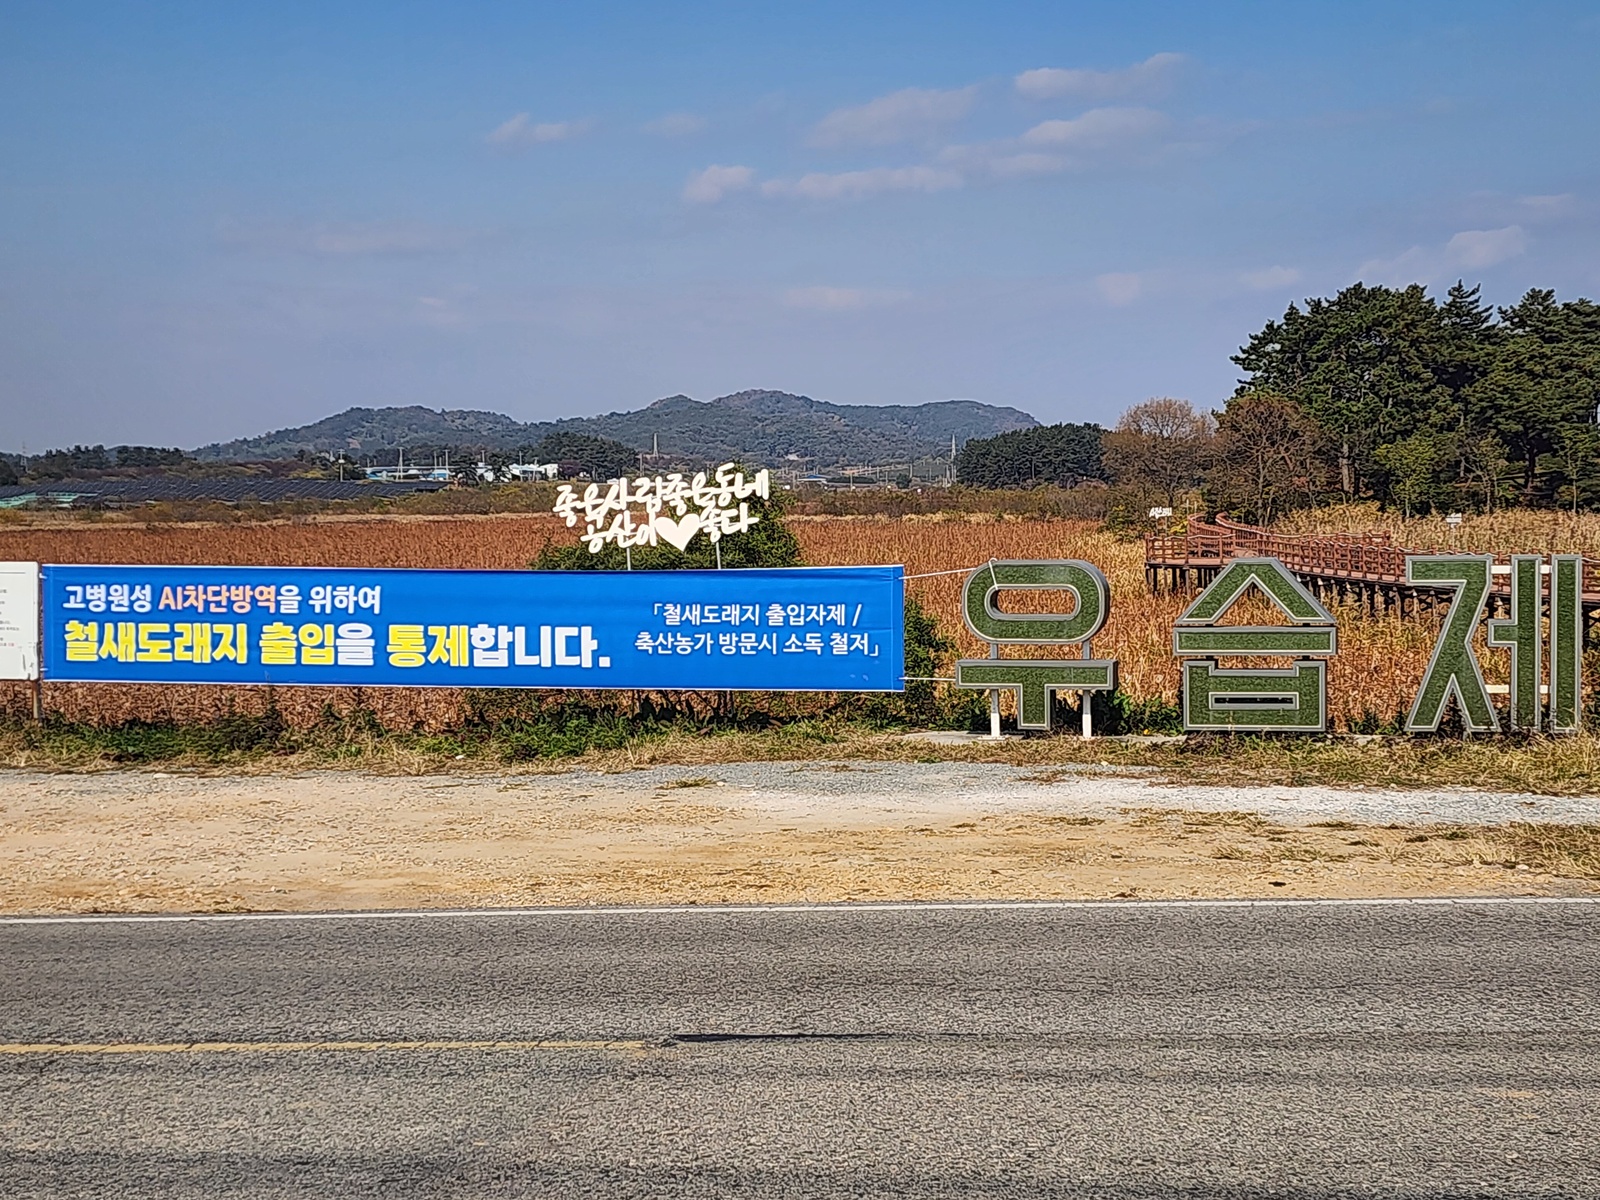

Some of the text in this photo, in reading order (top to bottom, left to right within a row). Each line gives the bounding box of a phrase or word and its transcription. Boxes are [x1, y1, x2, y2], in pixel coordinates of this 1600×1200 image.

[63, 585, 381, 614] 고병원성 AI차단방역을 위하여
[766, 604, 846, 626] 출입자제
[64, 620, 611, 668] 철새도래지 출입을 통제합니다.
[635, 632, 714, 655] 축산농가
[719, 633, 777, 655] 방문시
[783, 633, 825, 655] 소독
